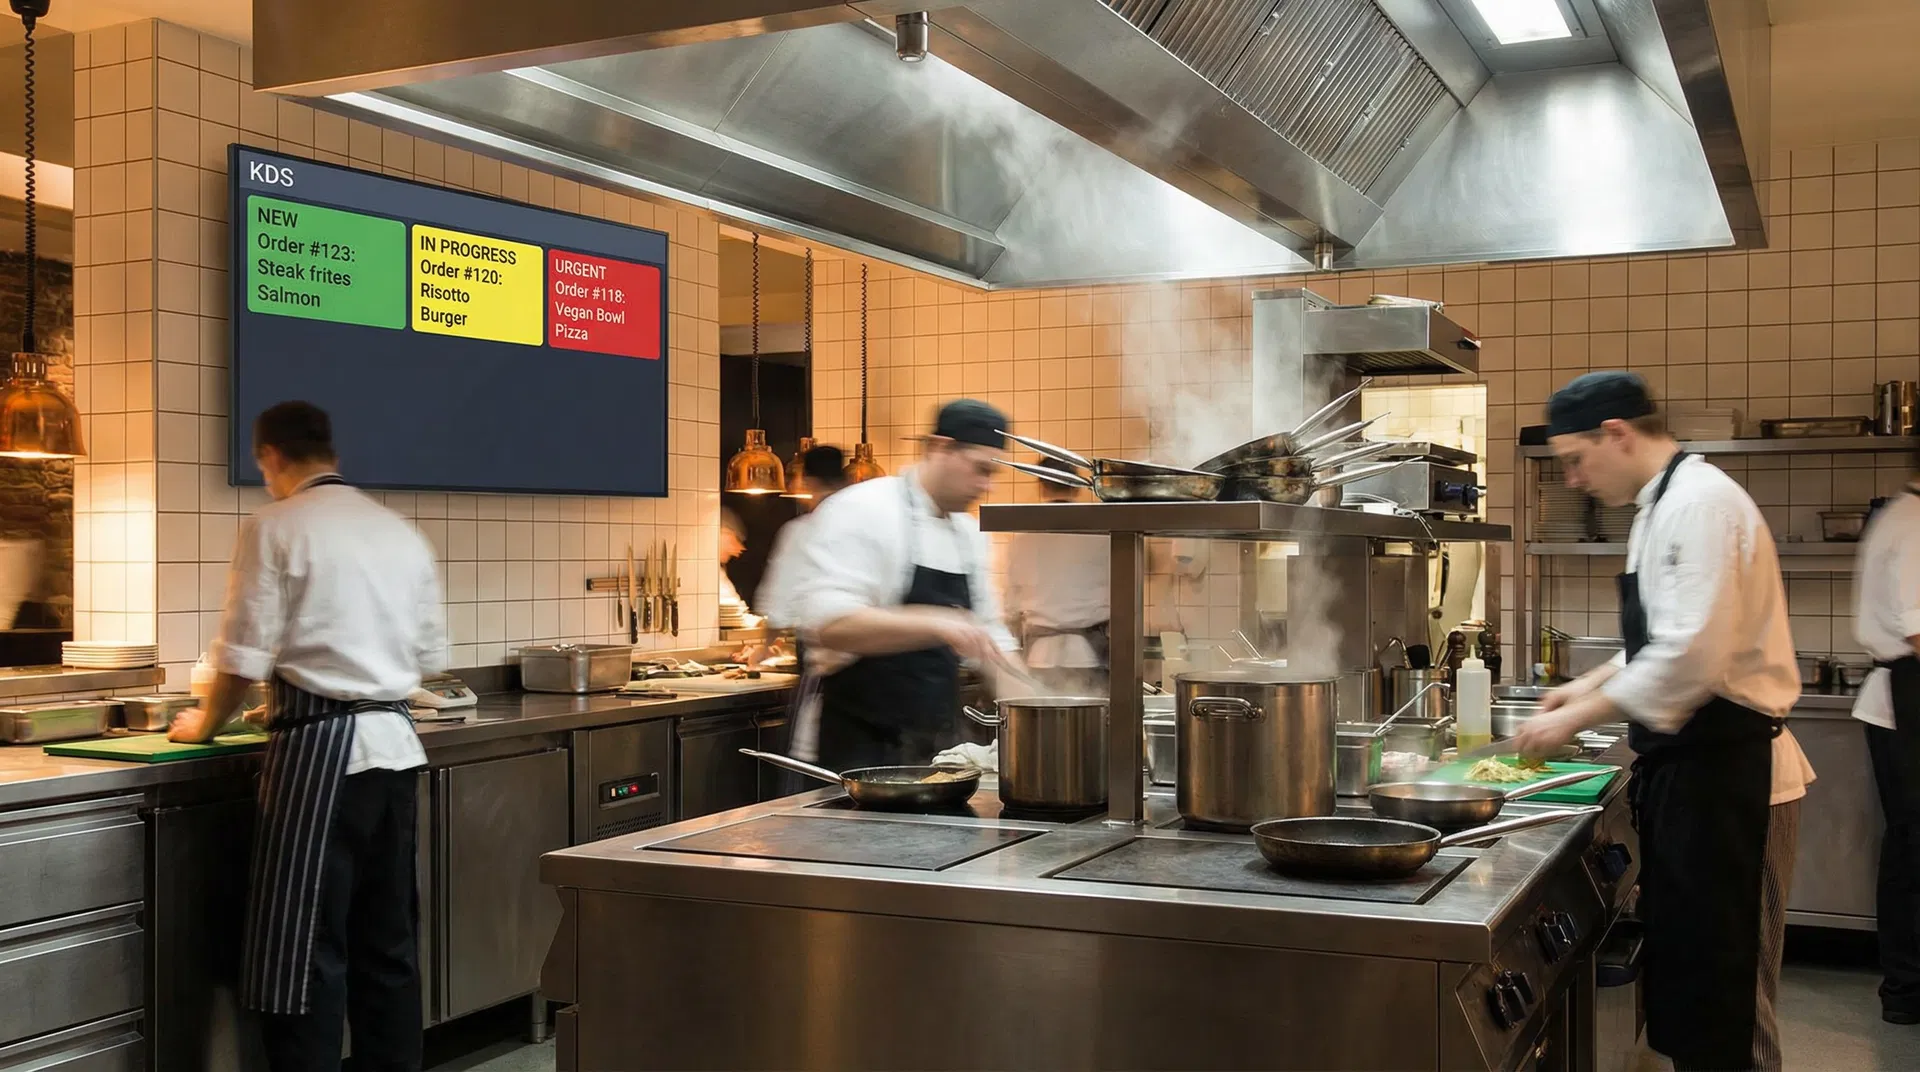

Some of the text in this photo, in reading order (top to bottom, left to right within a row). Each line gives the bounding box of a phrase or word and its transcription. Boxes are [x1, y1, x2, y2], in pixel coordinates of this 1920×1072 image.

[251, 161, 293, 186] KDS
[259, 207, 297, 228] NEW
[258, 232, 356, 263] Order #123:
[421, 236, 517, 265] IN PROGRESS
[258, 259, 350, 286] Steak frites
[421, 259, 502, 286] Order #120:
[555, 258, 607, 280] URGENT
[258, 285, 320, 307] Salmon
[421, 283, 469, 303] Risotto
[556, 281, 626, 304] Order #118:
[421, 306, 467, 327] Burger
[555, 302, 624, 324] Vegan Bowl
[556, 324, 588, 340] Pizza
